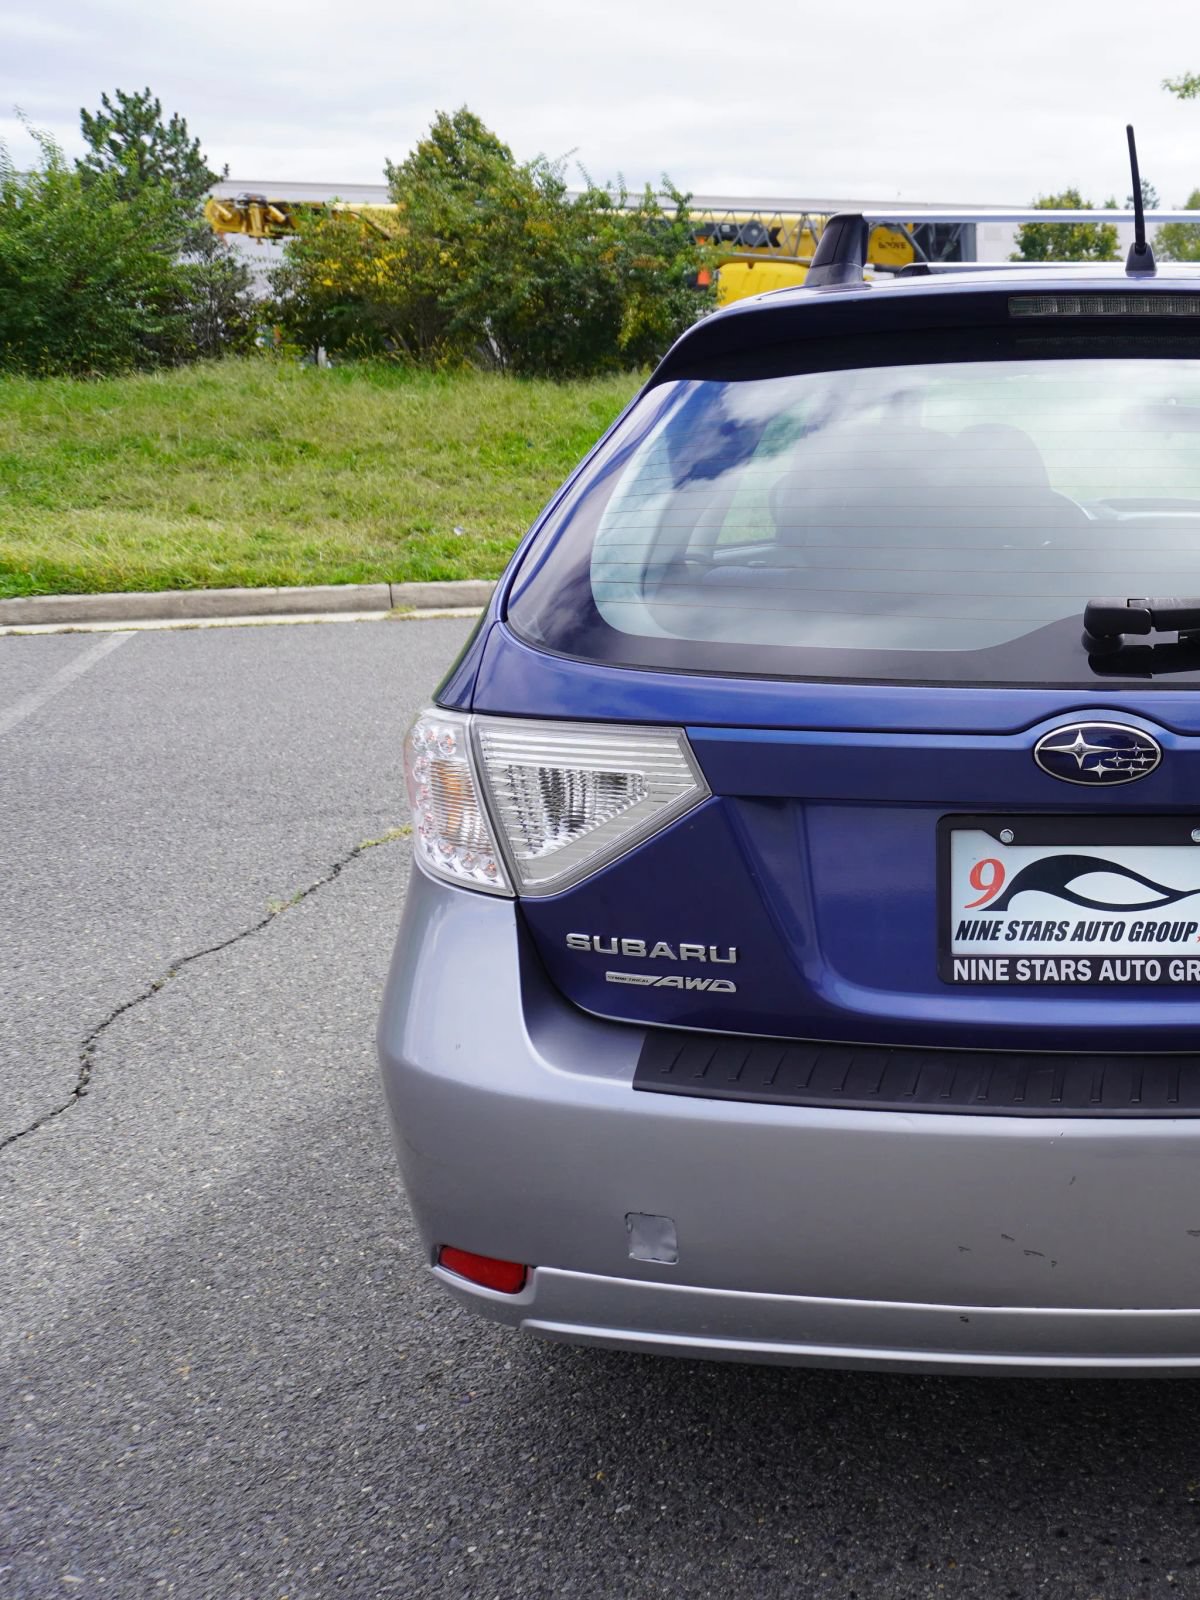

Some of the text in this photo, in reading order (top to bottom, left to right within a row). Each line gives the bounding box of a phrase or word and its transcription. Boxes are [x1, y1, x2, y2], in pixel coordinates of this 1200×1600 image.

[963, 858, 1006, 909] 9
[955, 920, 1198, 942] NINE STARS AUTO GROUP
[566, 933, 737, 964] SUBARU
[953, 959, 1009, 981] NINE
[1016, 959, 1092, 982] STARS
[1098, 959, 1161, 982] AUTO
[653, 975, 737, 993] AWD
